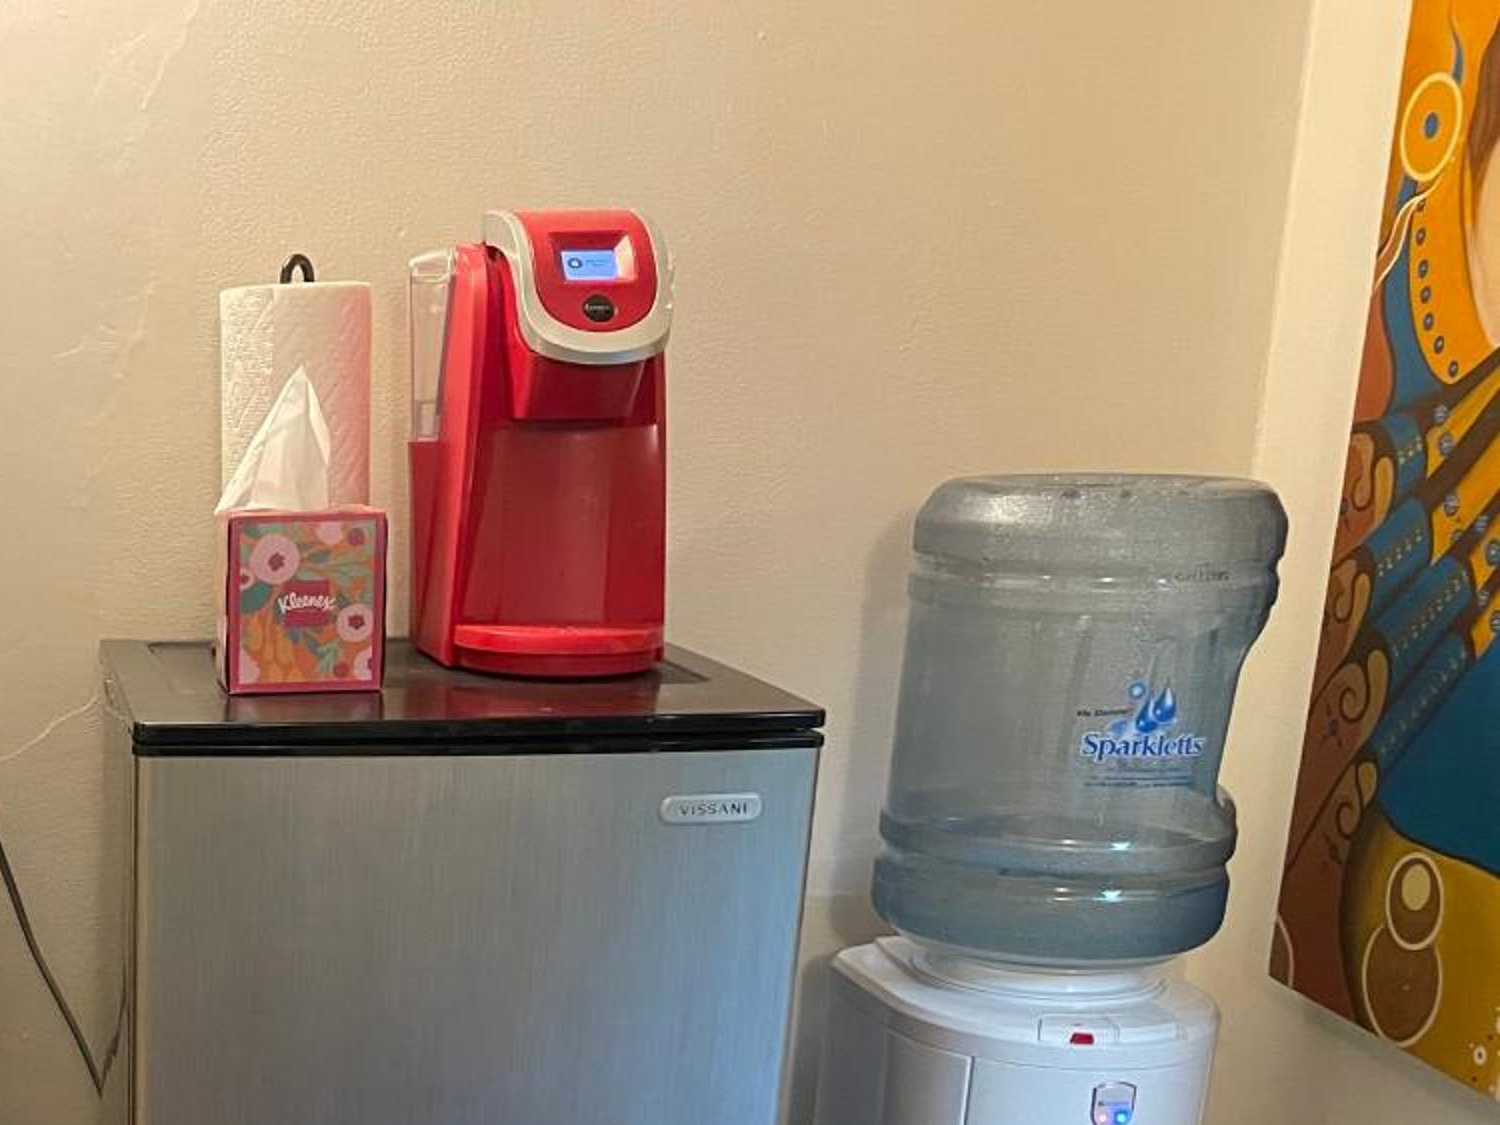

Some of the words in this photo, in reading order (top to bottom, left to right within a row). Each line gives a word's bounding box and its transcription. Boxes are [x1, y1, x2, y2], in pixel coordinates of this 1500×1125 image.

[276, 592, 337, 613] Kleenex
[1082, 732, 1206, 762] Sparkletts
[679, 803, 747, 816] VISSANI
